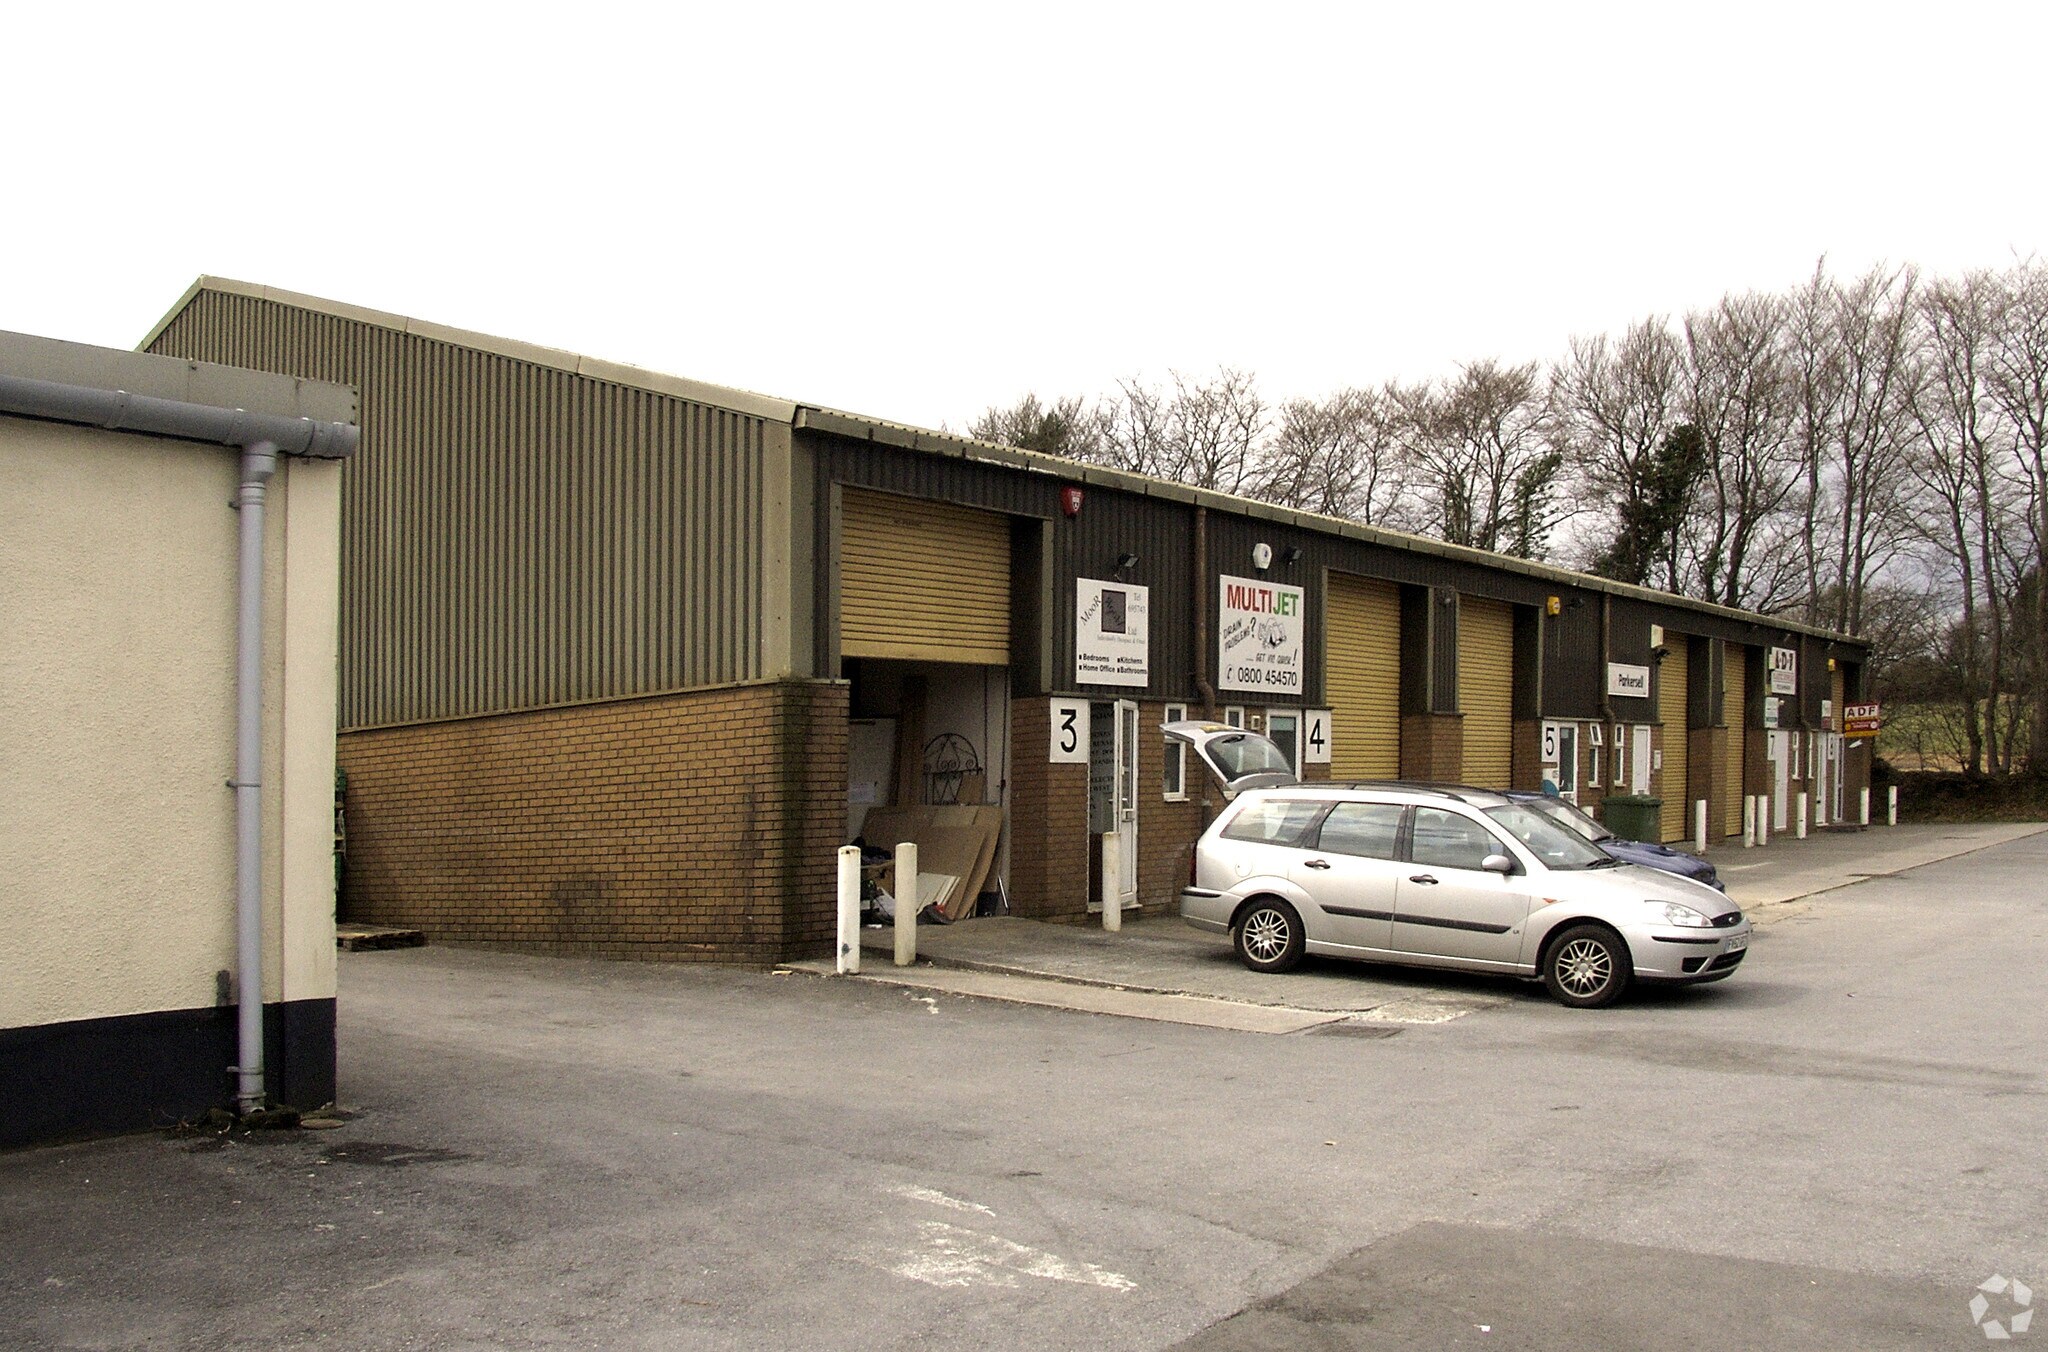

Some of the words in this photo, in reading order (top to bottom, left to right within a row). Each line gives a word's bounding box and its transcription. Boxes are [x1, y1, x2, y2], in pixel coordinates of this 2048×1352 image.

[1227, 584, 1299, 617] MULTIJET
[1083, 653, 1109, 663] Bedrooms
[1120, 656, 1143, 665] Kitchens
[1083, 664, 1099, 672] Home
[1100, 664, 1115, 673] Office
[1120, 666, 1147, 675] Bathrooms
[1237, 667, 1262, 684] 0800
[1265, 669, 1297, 687] 454570
[1618, 674, 1644, 688] Parkersell
[1061, 709, 1076, 753] 3
[1309, 718, 1325, 754] 4
[1546, 727, 1554, 756] 5
[1770, 735, 1775, 755] 7
